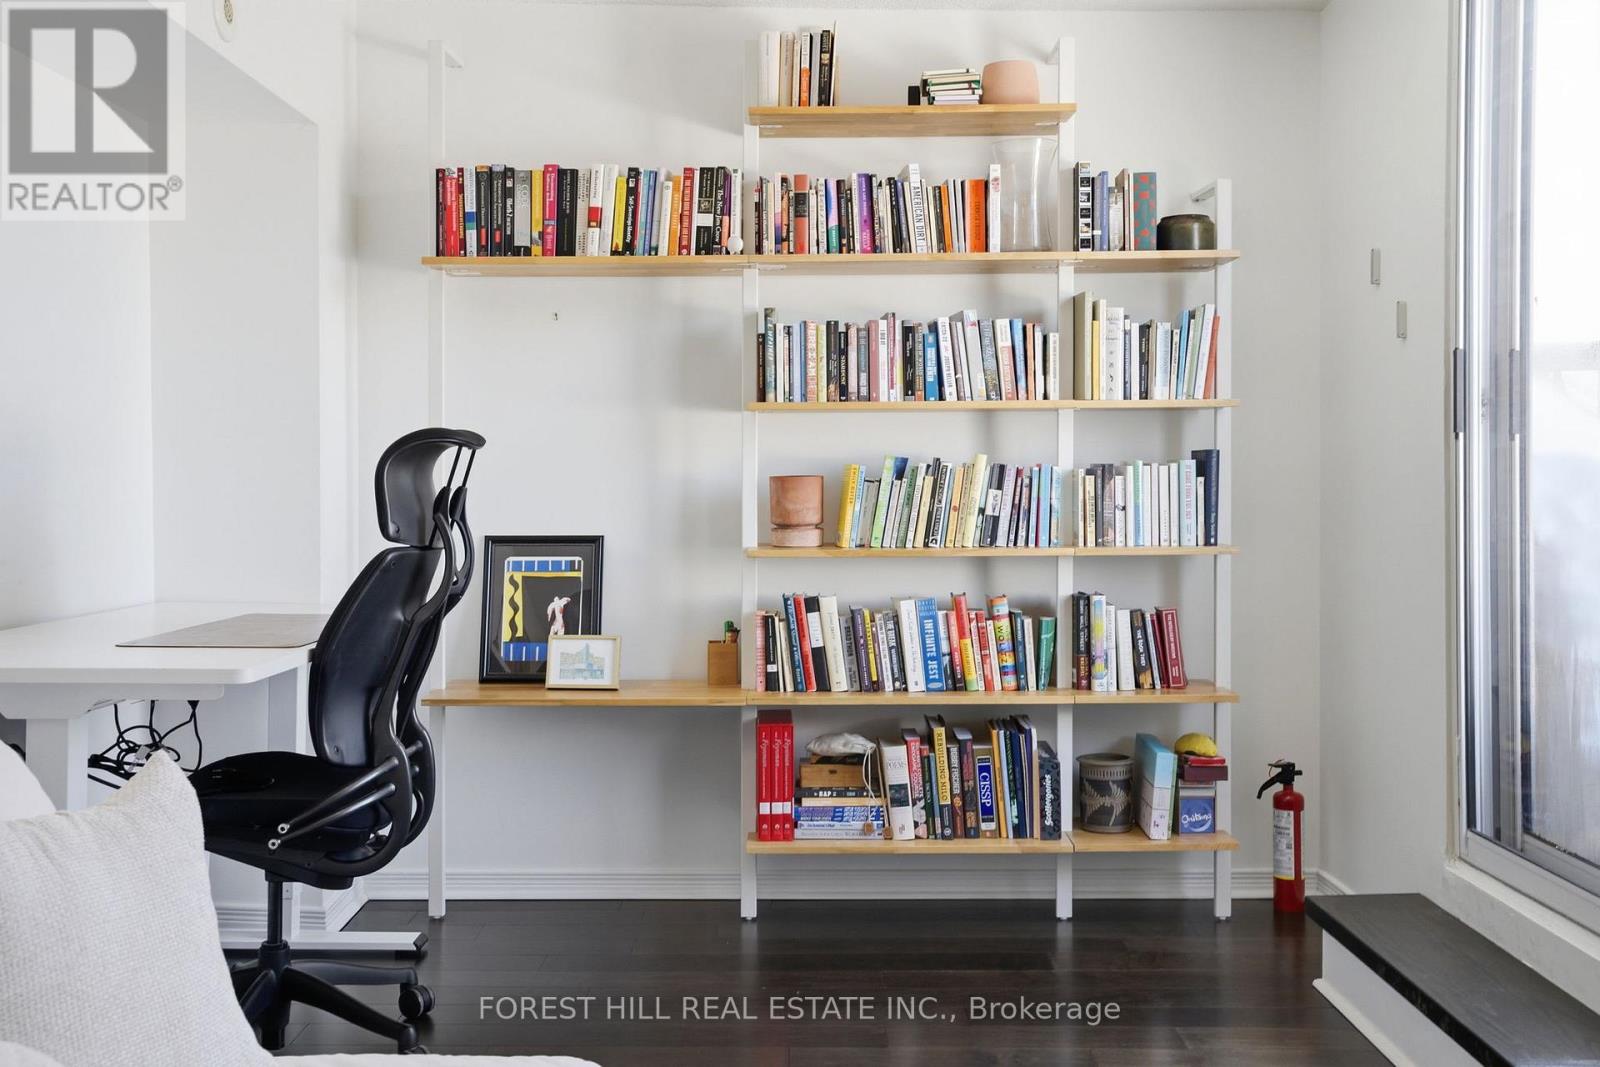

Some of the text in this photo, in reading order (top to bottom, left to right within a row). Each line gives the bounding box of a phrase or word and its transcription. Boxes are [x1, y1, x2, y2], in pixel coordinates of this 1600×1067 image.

[912, 186, 926, 241] AMERICAN DIRT
[846, 642, 854, 656] THOR
[887, 631, 897, 648] BREAK
[924, 619, 938, 680] INFINITE JEST
[760, 739, 769, 768] Feynman
[774, 738, 782, 767] Feynman
[936, 732, 948, 801] REBUILDING MILO
[950, 747, 960, 794] BOBBY FISCHER
[980, 772, 991, 807] CISSP
[1044, 774, 1054, 826] Scattergories
